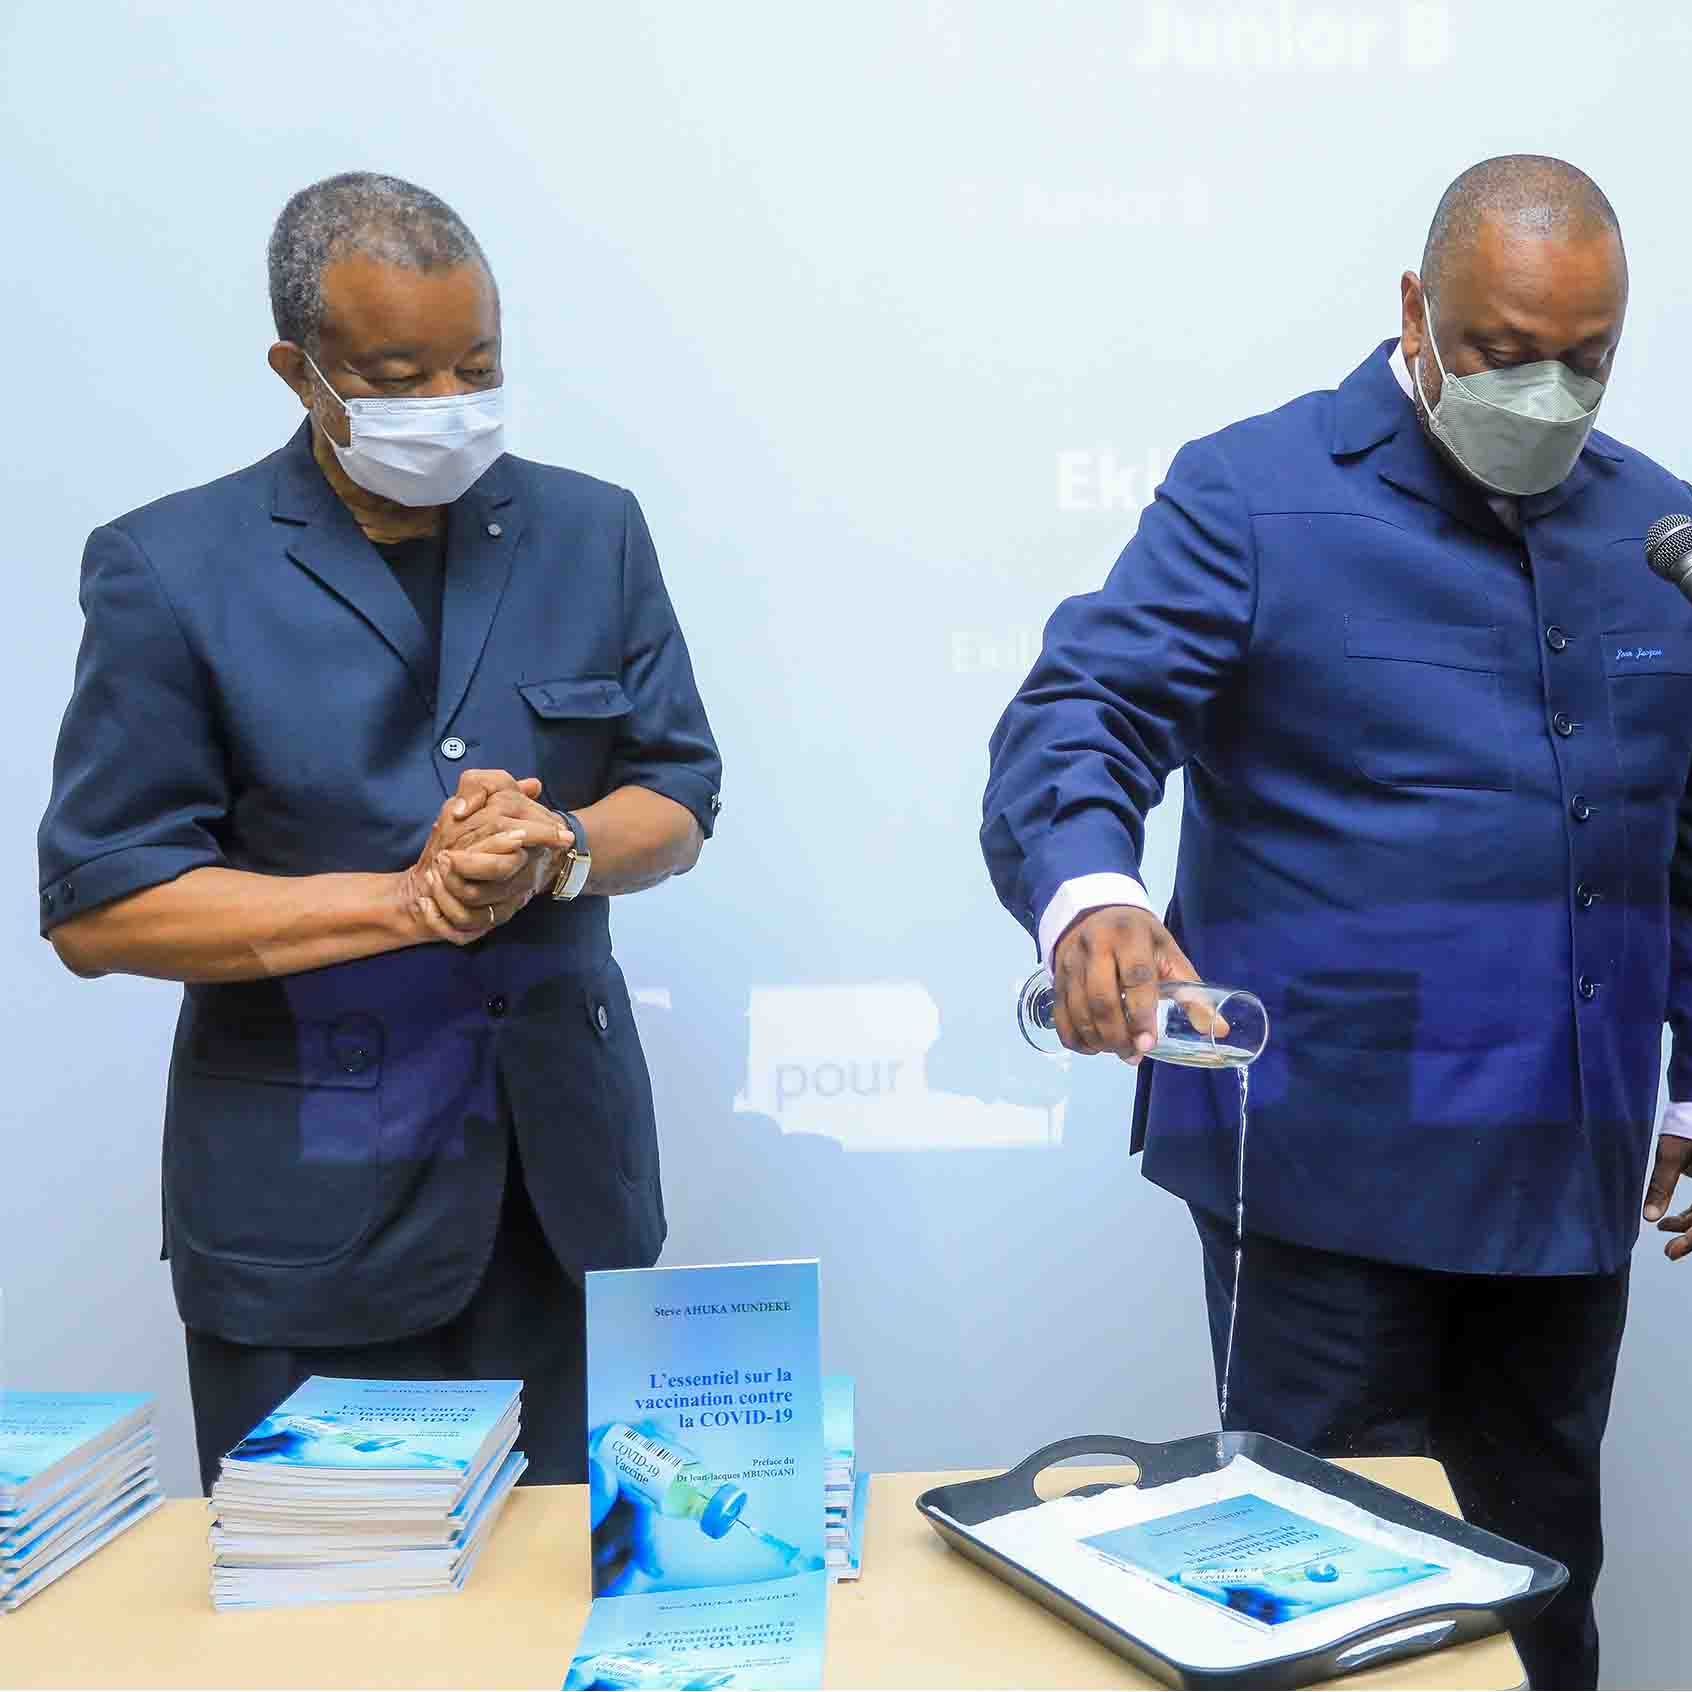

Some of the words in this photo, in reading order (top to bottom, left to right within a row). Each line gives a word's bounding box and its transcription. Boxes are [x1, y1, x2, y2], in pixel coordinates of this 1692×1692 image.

[775, 1059, 904, 1112] pour
[655, 1306, 681, 1317] Steve
[684, 1304, 728, 1316] AHUKA
[730, 1301, 791, 1314] MUNDEKE
[744, 1372, 772, 1384] sur
[777, 1368, 792, 1382] la
[635, 1390, 734, 1410] vaccination
[739, 1391, 793, 1405] contre
[679, 1413, 694, 1428] la
[700, 1407, 793, 1428] COVID-19
[611, 1440, 660, 1478] COVID-19
[614, 1455, 650, 1486] Vaccine
